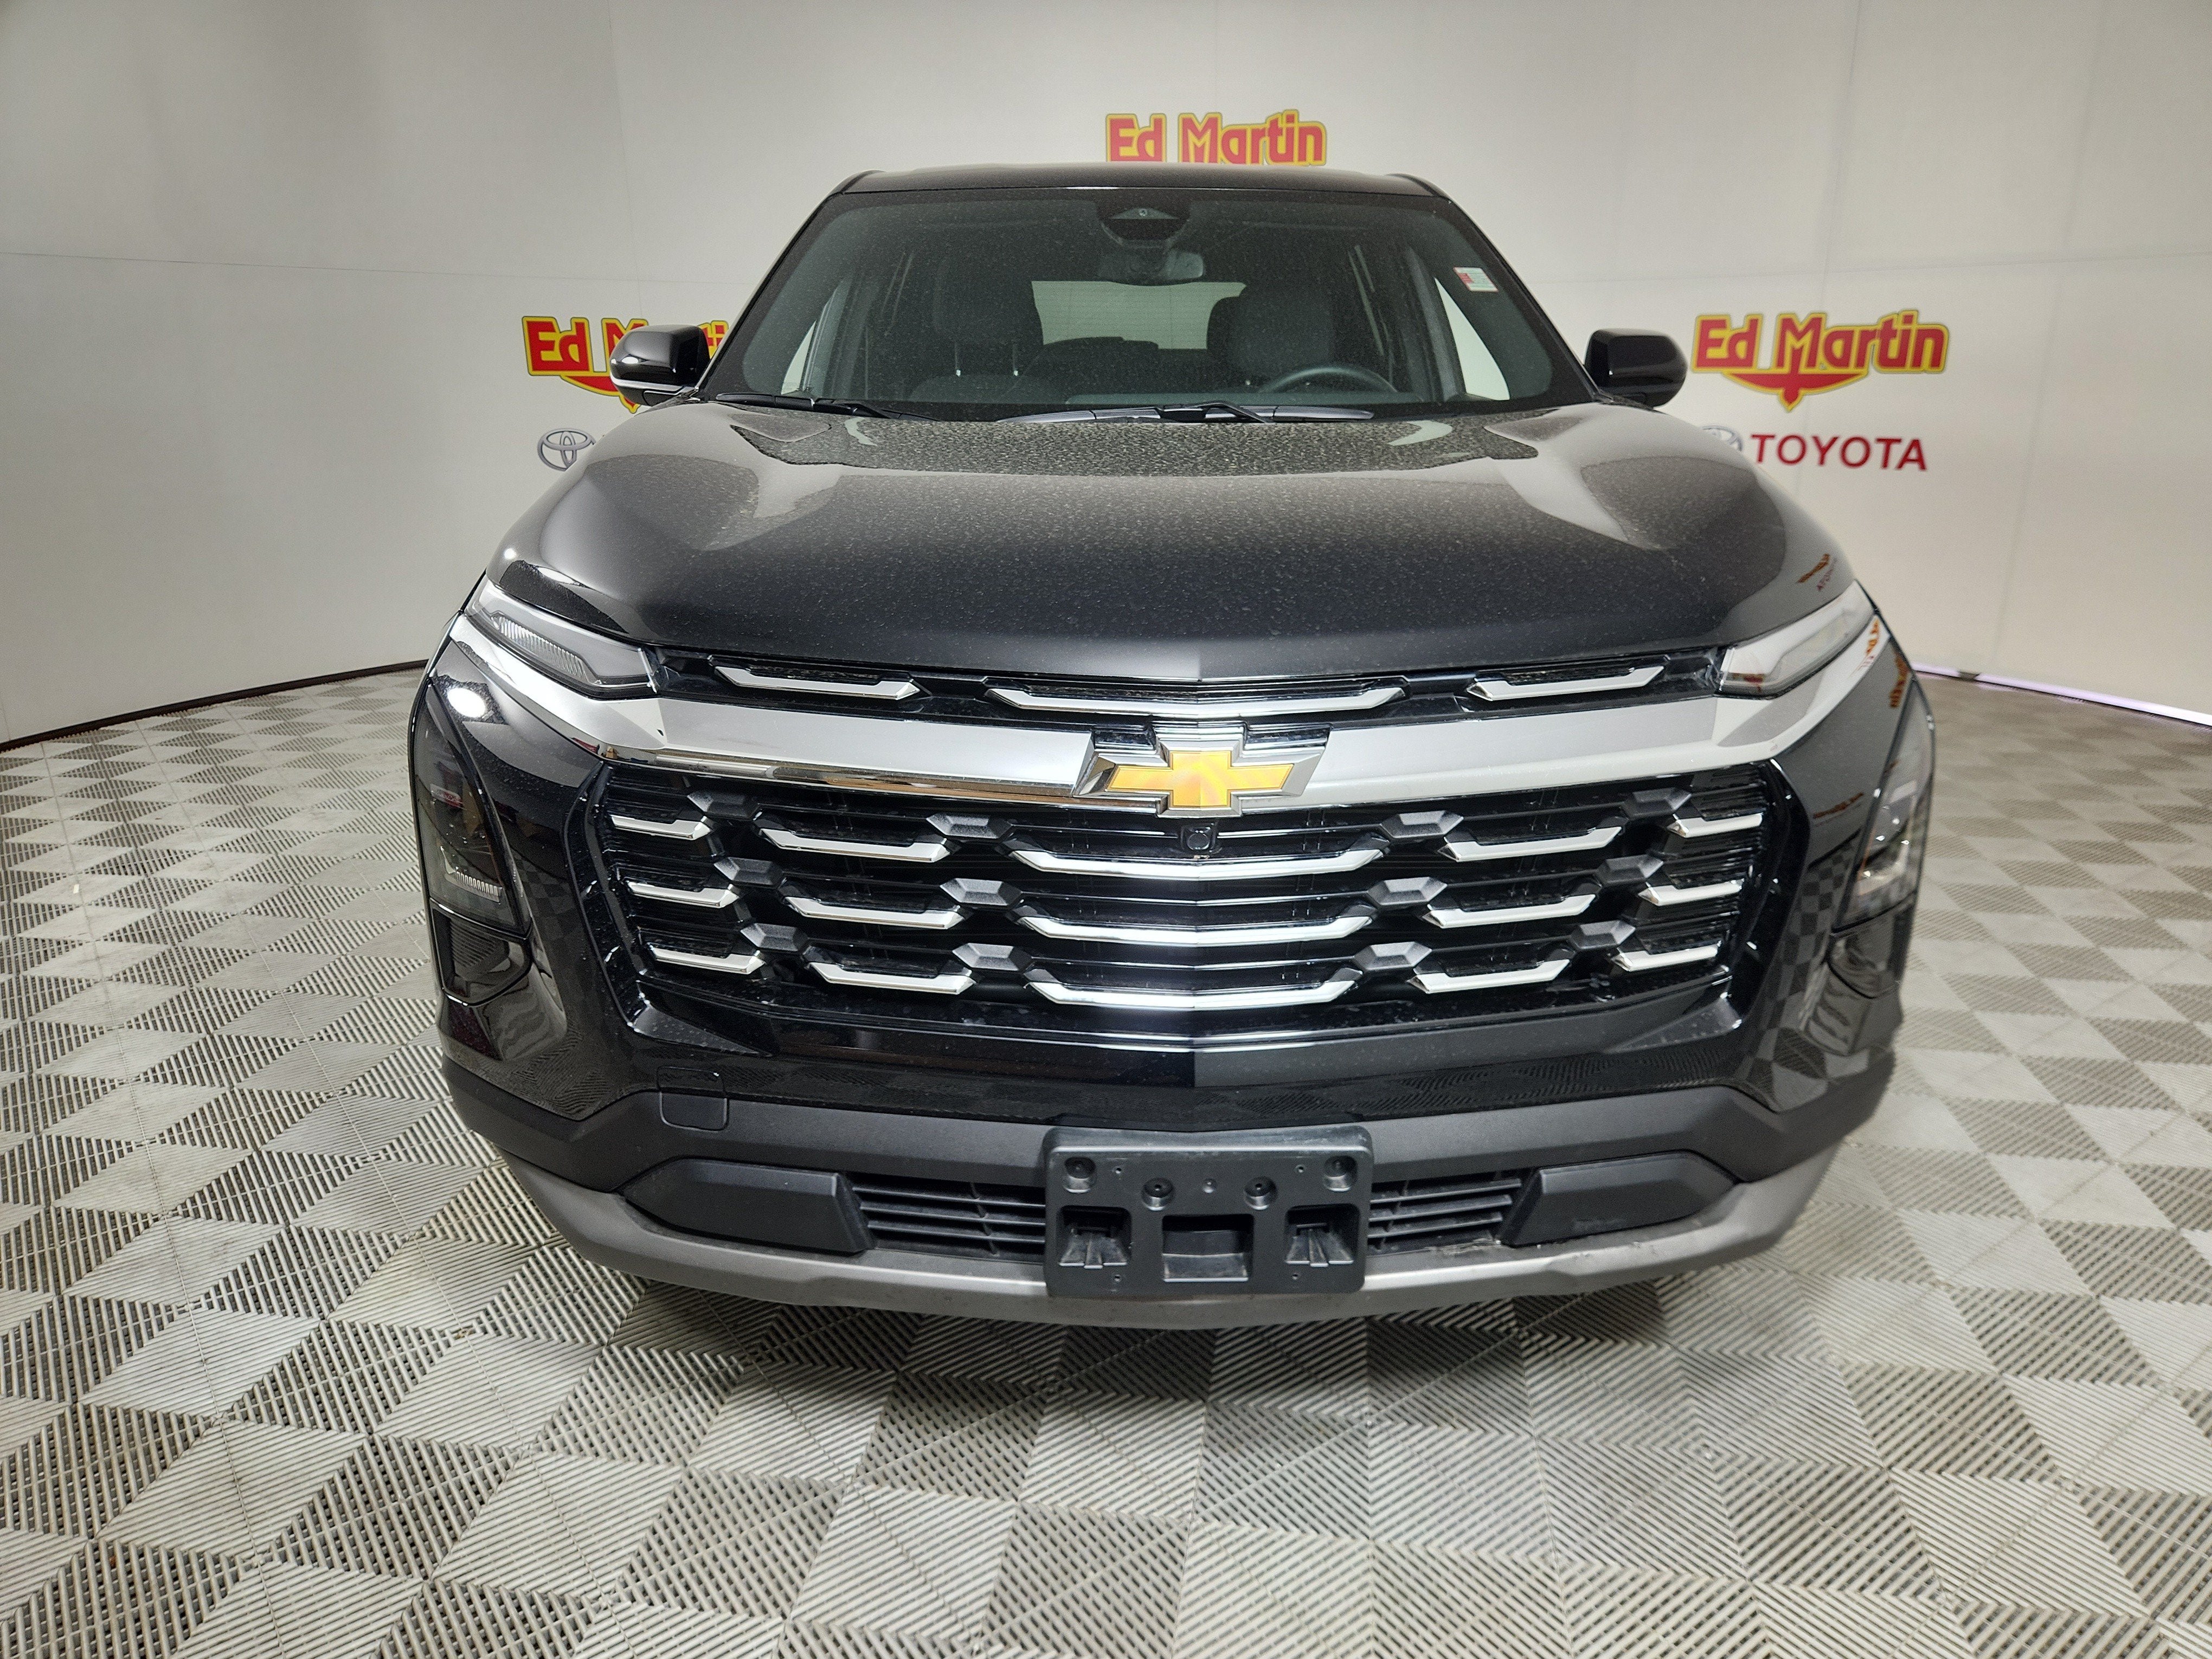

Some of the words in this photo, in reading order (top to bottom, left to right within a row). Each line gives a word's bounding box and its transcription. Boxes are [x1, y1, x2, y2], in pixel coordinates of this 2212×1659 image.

[1107, 114, 1166, 162] Ed
[1179, 110, 1326, 165] Martin
[522, 317, 593, 375] Ed
[1693, 314, 1762, 371] Ed
[1774, 310, 1949, 373] Martin
[1751, 433, 1927, 471] TOYOTA
